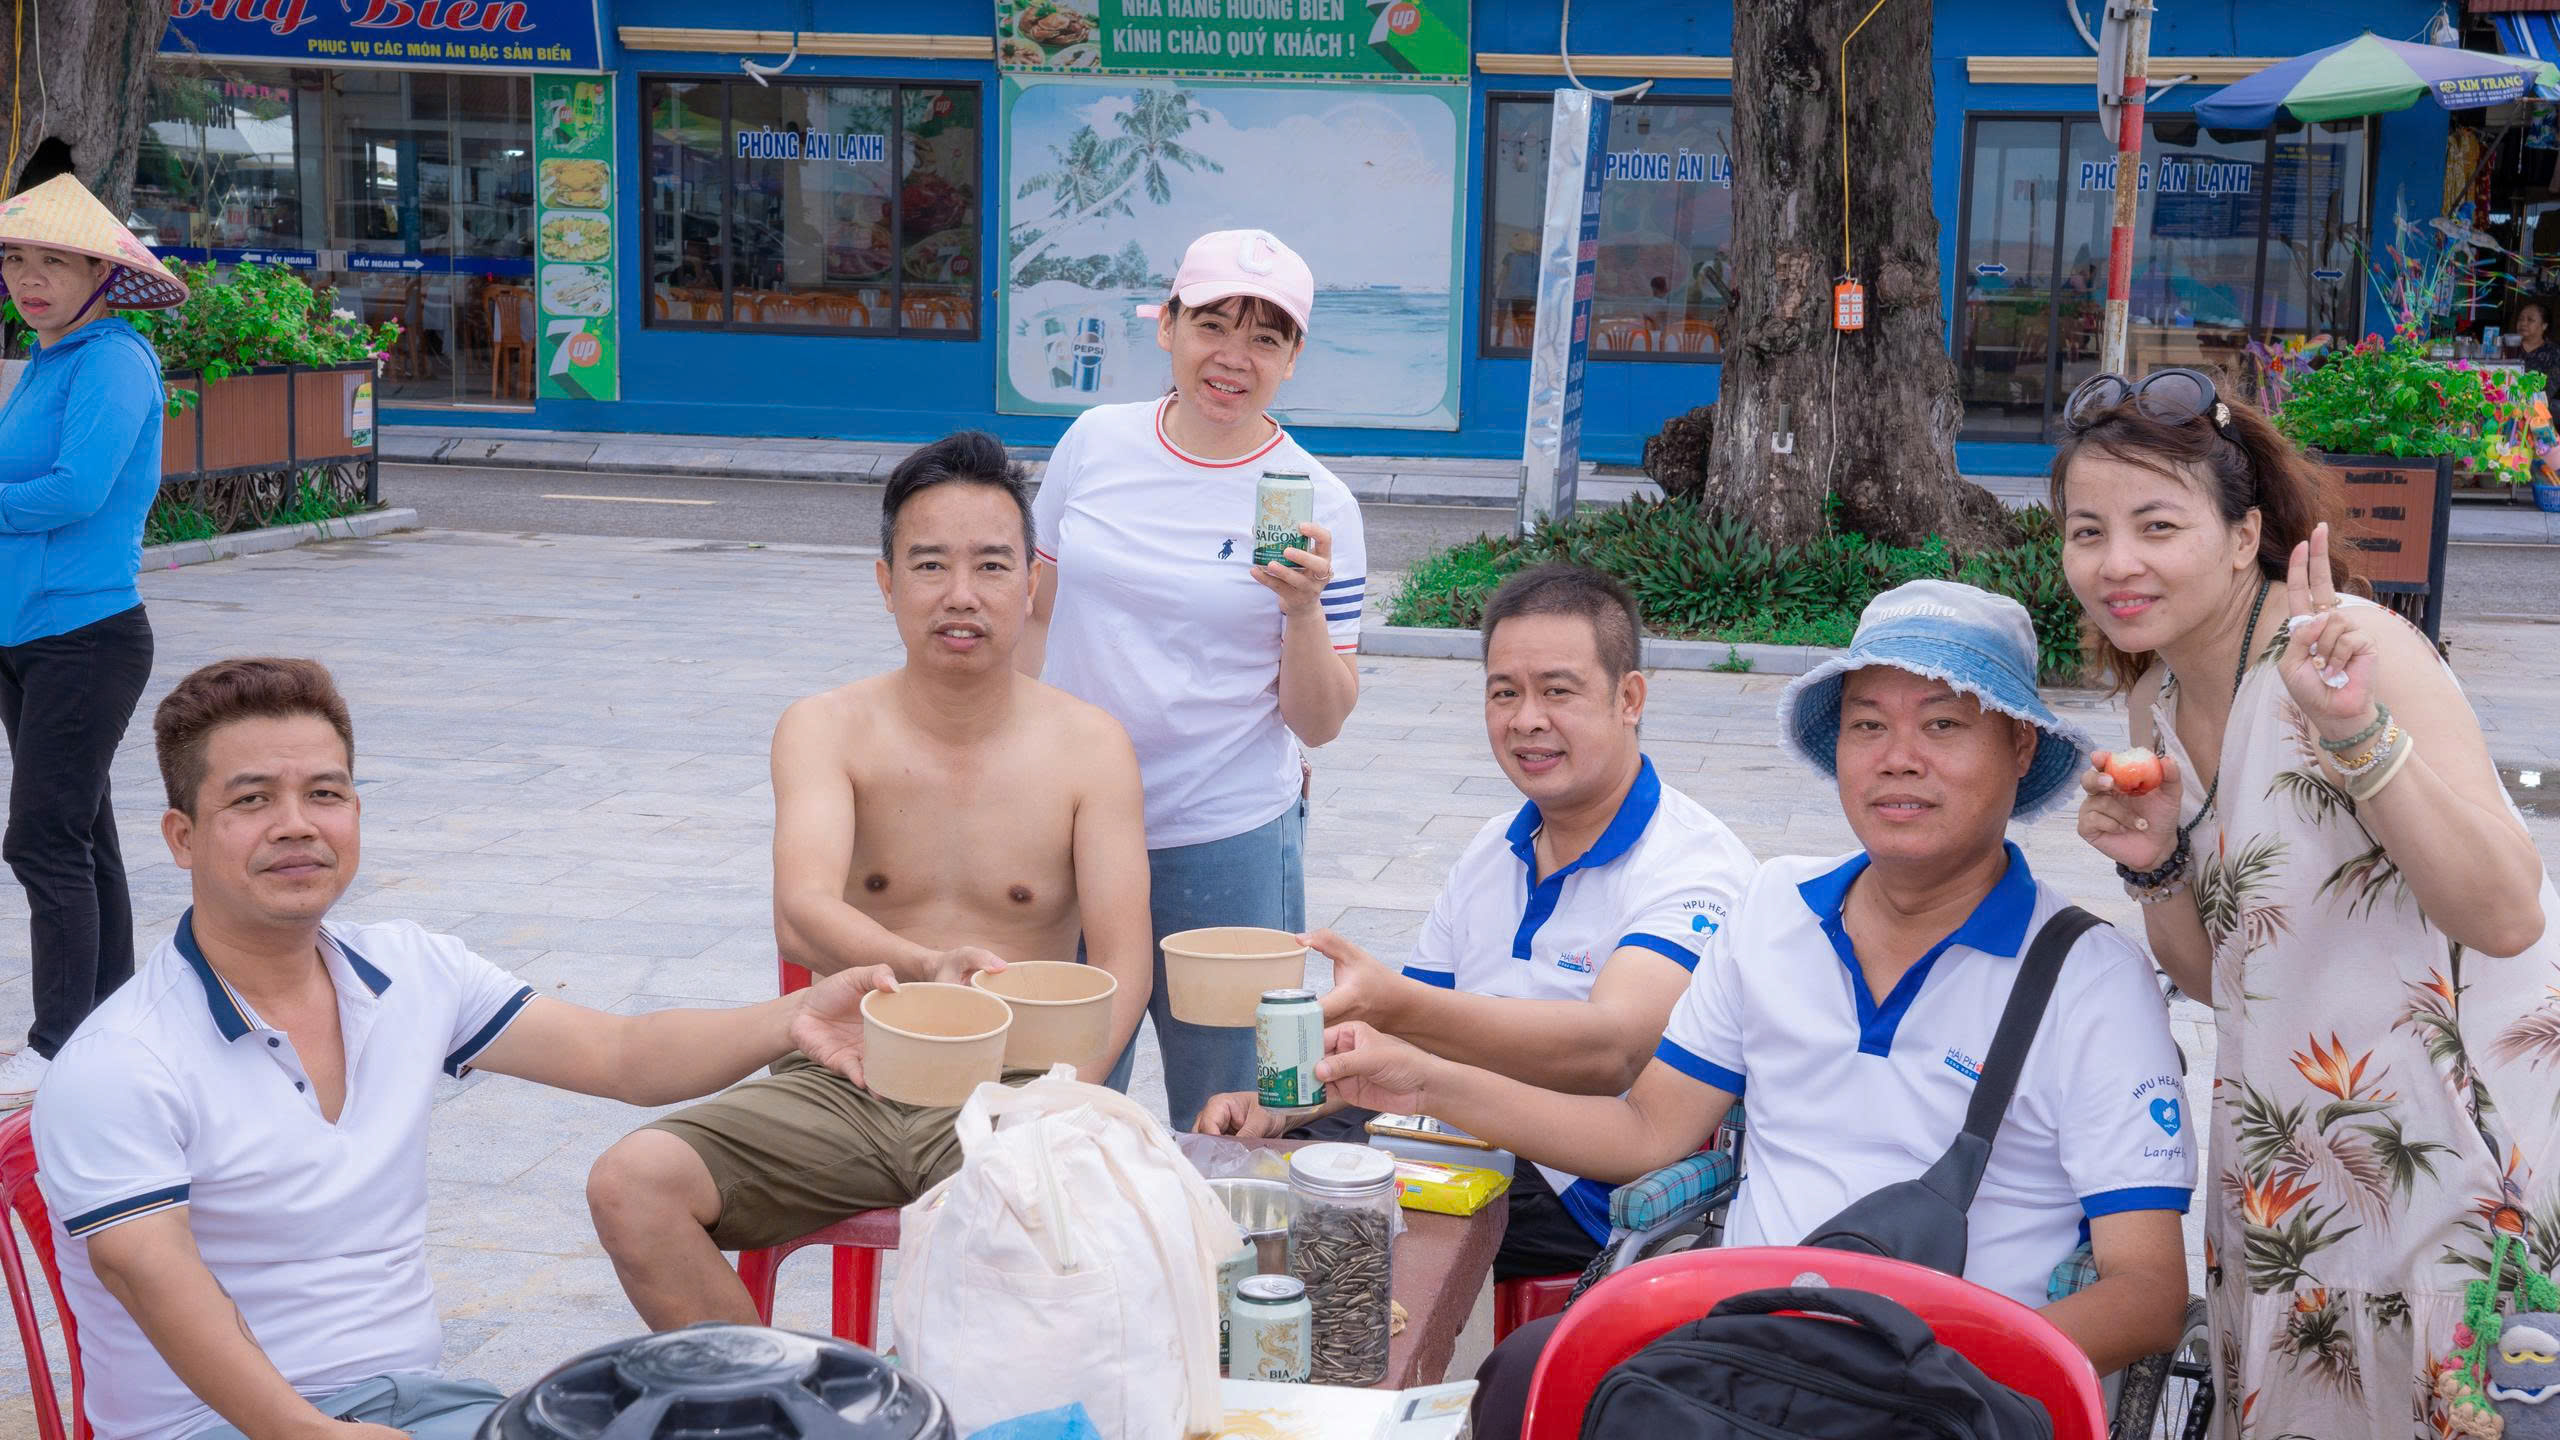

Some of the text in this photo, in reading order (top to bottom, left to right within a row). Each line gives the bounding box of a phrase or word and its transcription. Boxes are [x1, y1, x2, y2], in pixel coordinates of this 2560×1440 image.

[1113, 23, 1355, 58] KÍNH CHÀO QUÝ KHÁCH !
[308, 39, 347, 56] PHỤC
[351, 41, 369, 57] VỤ
[373, 40, 403, 56] CÁC
[407, 41, 441, 57] MÓN
[446, 42, 466, 58] ĂN
[470, 43, 499, 61] ĐẶC
[503, 41, 533, 60] SẢN
[2457, 75, 2524, 92] KIM TRANG
[737, 125, 884, 166] PHÒNG ĂN LẠNH
[1604, 147, 1671, 181] PHÒNG
[1675, 147, 1704, 182] ĂN
[1710, 153, 1734, 189] LẠ
[2079, 156, 2252, 198] PHÒG ĂN LẠNH
[371, 257, 399, 268] NGANG
[1074, 344, 1104, 355] PEPSI
[1256, 530, 1298, 543] SAIGON
[1268, 524, 1282, 532] BIA
[1682, 900, 1727, 918] HPU HEA
[2132, 1078, 2156, 1099] HPU
[1269, 1370, 1290, 1379] BIA
